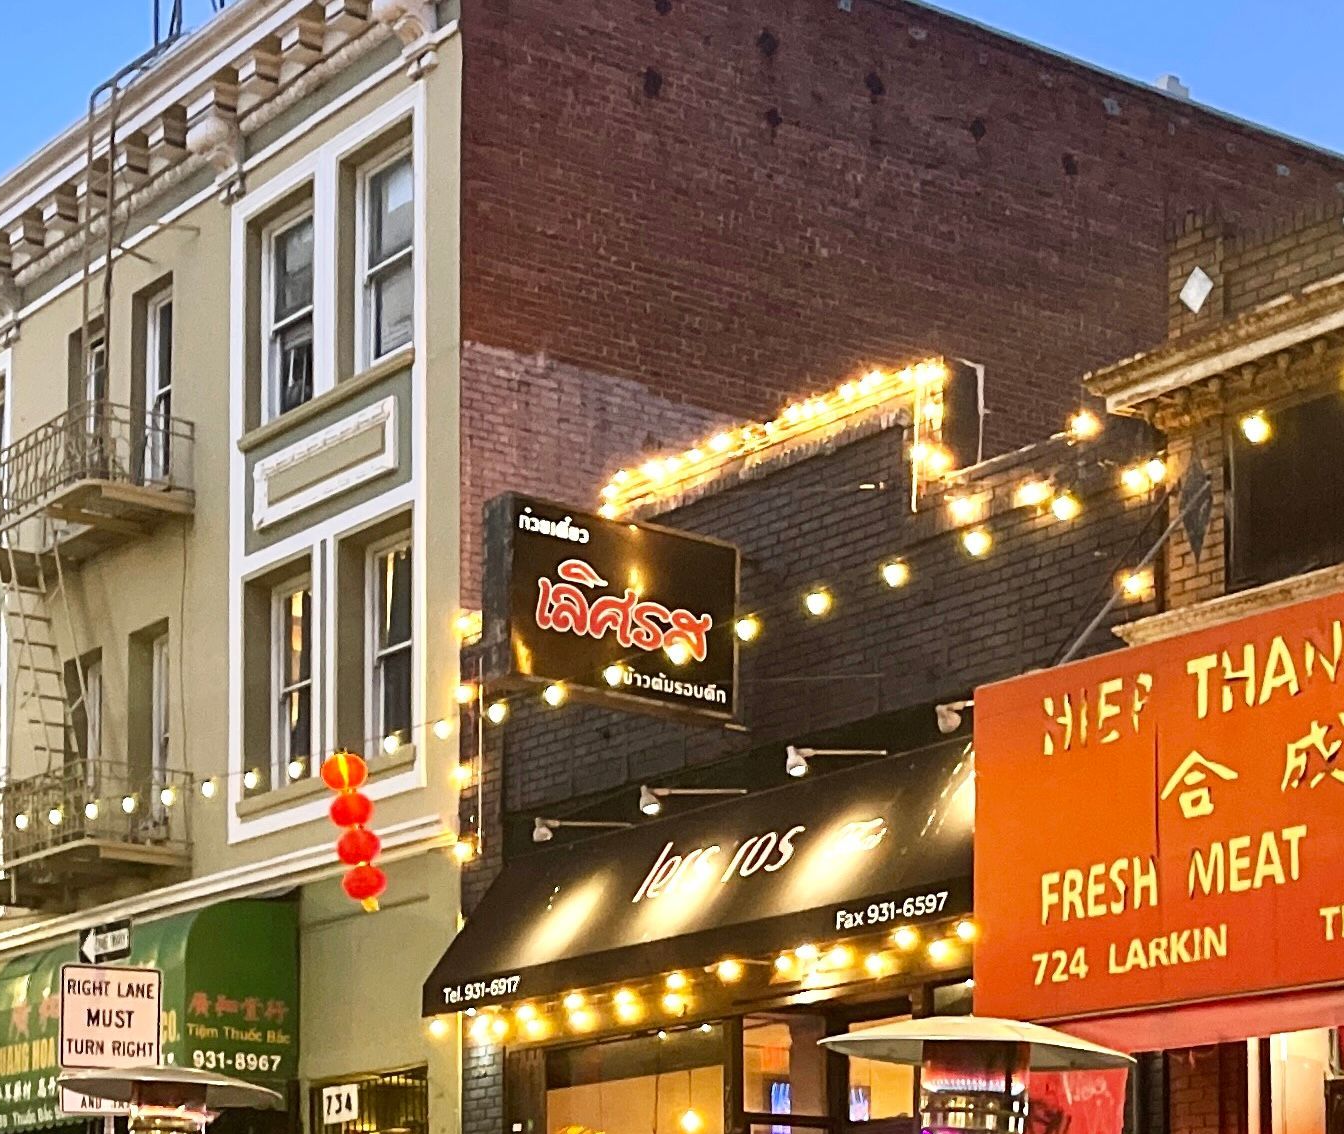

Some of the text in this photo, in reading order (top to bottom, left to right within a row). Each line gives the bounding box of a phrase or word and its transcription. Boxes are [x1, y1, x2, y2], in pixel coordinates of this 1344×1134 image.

[1040, 854, 1159, 926] FRESH
[1188, 824, 1308, 899] MEAT
[835, 890, 949, 931] Fax 931-6597
[1031, 947, 1089, 986] 724
[1108, 923, 1228, 974] LARKIN
[67, 978, 155, 1000] RIGHT LANE
[86, 1008, 135, 1029] MUST
[31, 1036, 56, 1072] HOA
[66, 1038, 154, 1058] TURN RIGHT
[193, 1049, 282, 1072] 931-8967
[80, 1096, 102, 1110] AND
